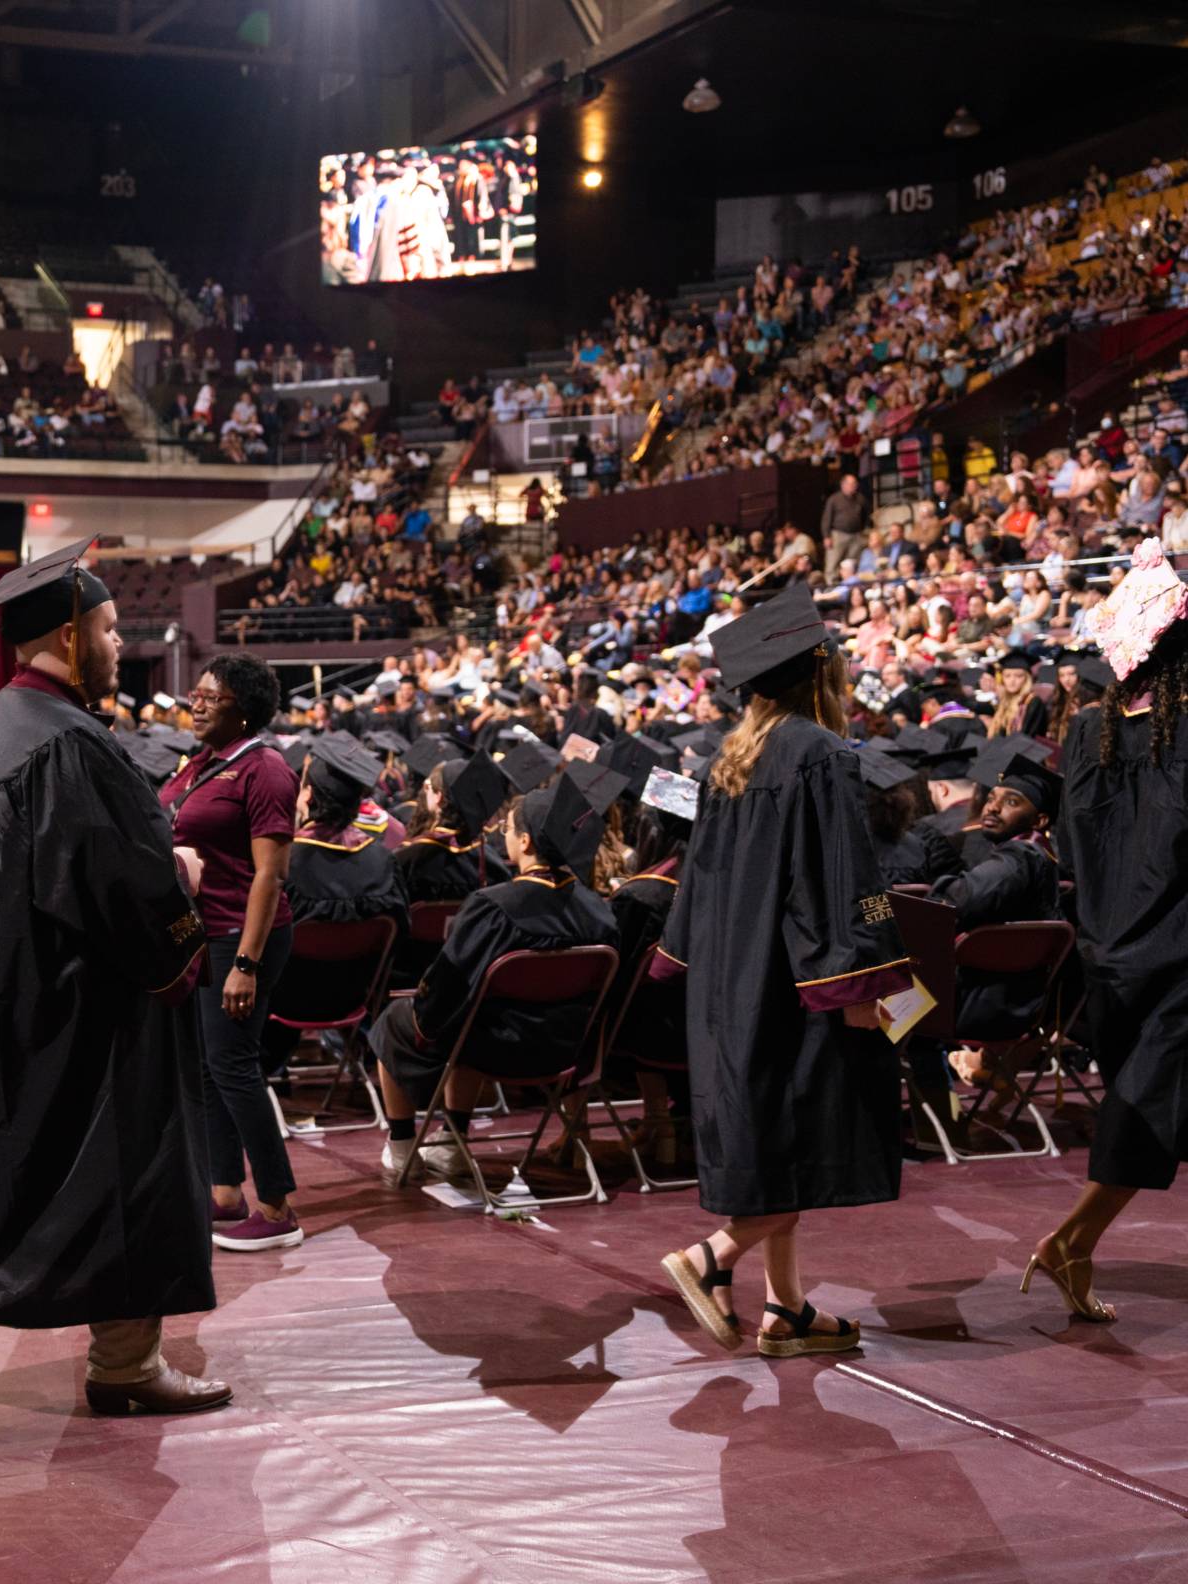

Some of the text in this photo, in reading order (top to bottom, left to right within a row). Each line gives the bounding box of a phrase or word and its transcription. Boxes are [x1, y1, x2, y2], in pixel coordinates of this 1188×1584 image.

[973, 166, 1006, 200] 106
[886, 184, 932, 214] 105
[858, 893, 890, 910] TEXA
